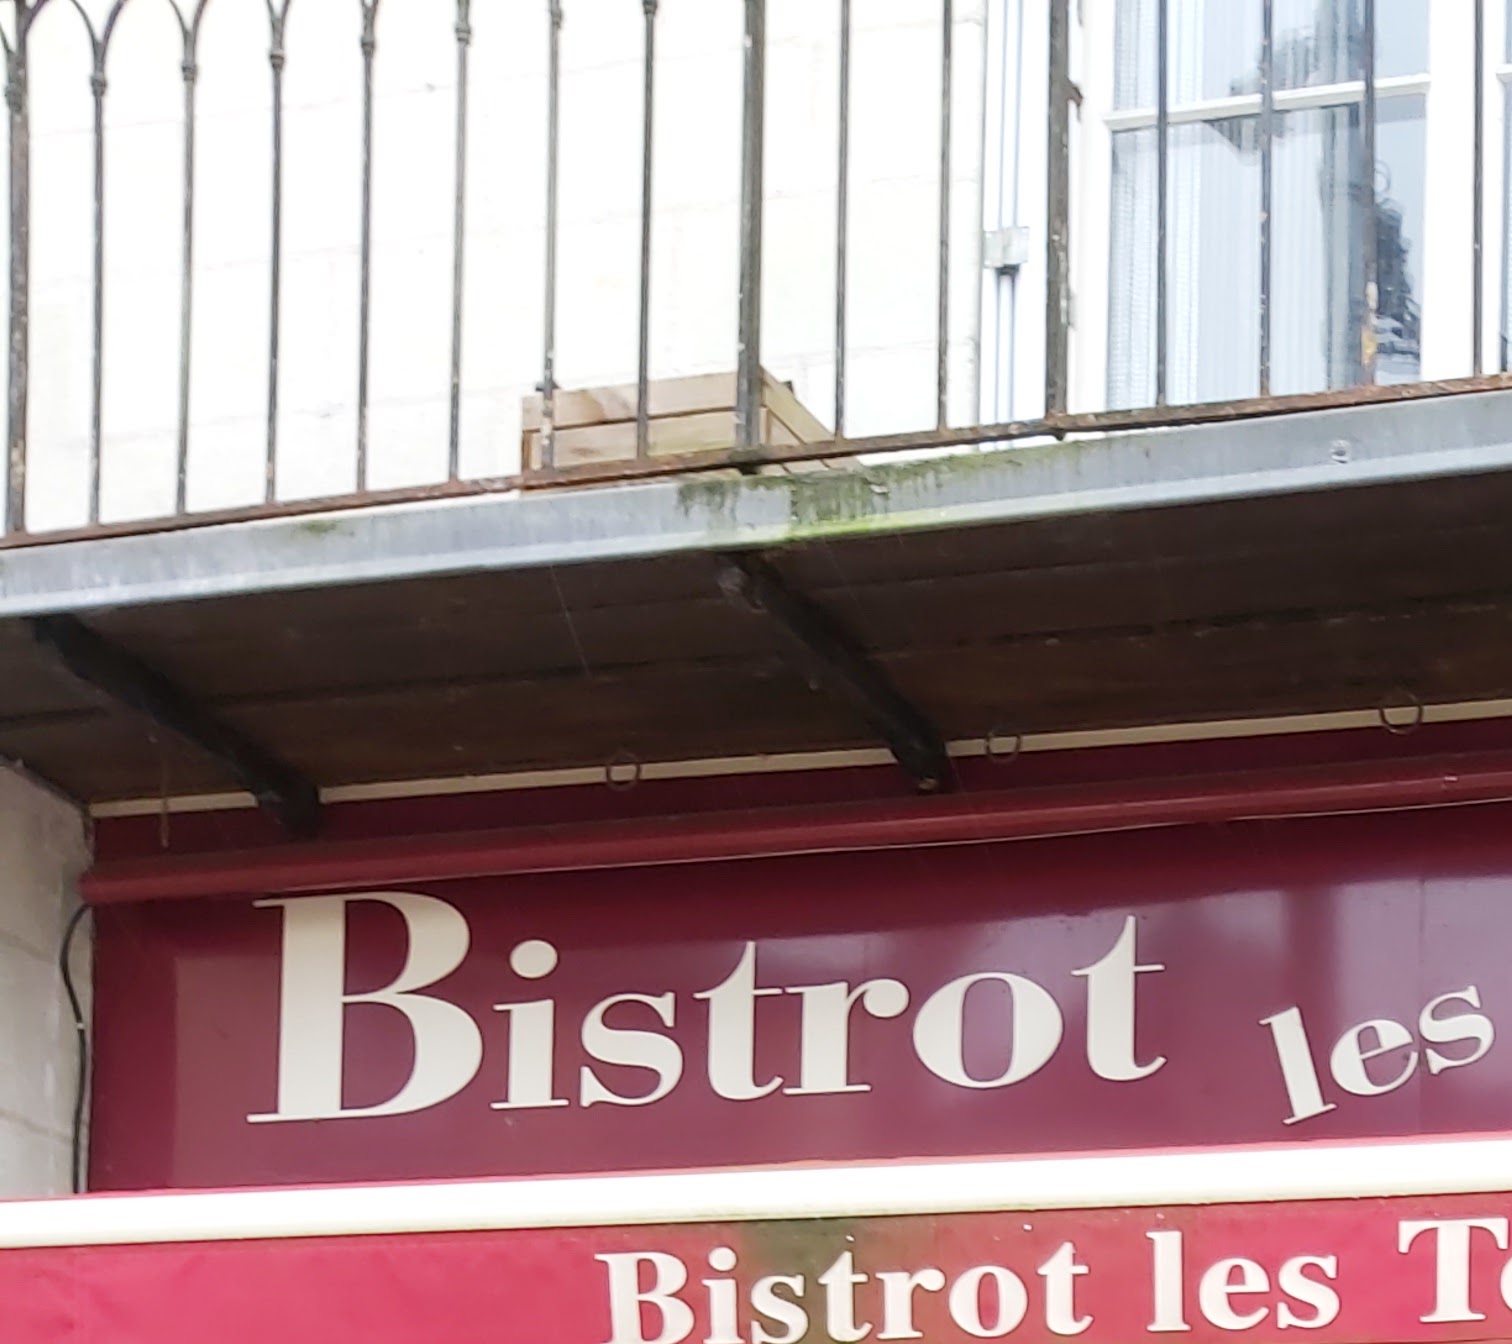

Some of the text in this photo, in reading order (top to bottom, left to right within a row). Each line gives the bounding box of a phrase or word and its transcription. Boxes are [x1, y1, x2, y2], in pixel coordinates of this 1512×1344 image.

[246, 890, 1167, 1126] Bistrot
[1258, 983, 1495, 1126] les
[1144, 1228, 1342, 1334] les
